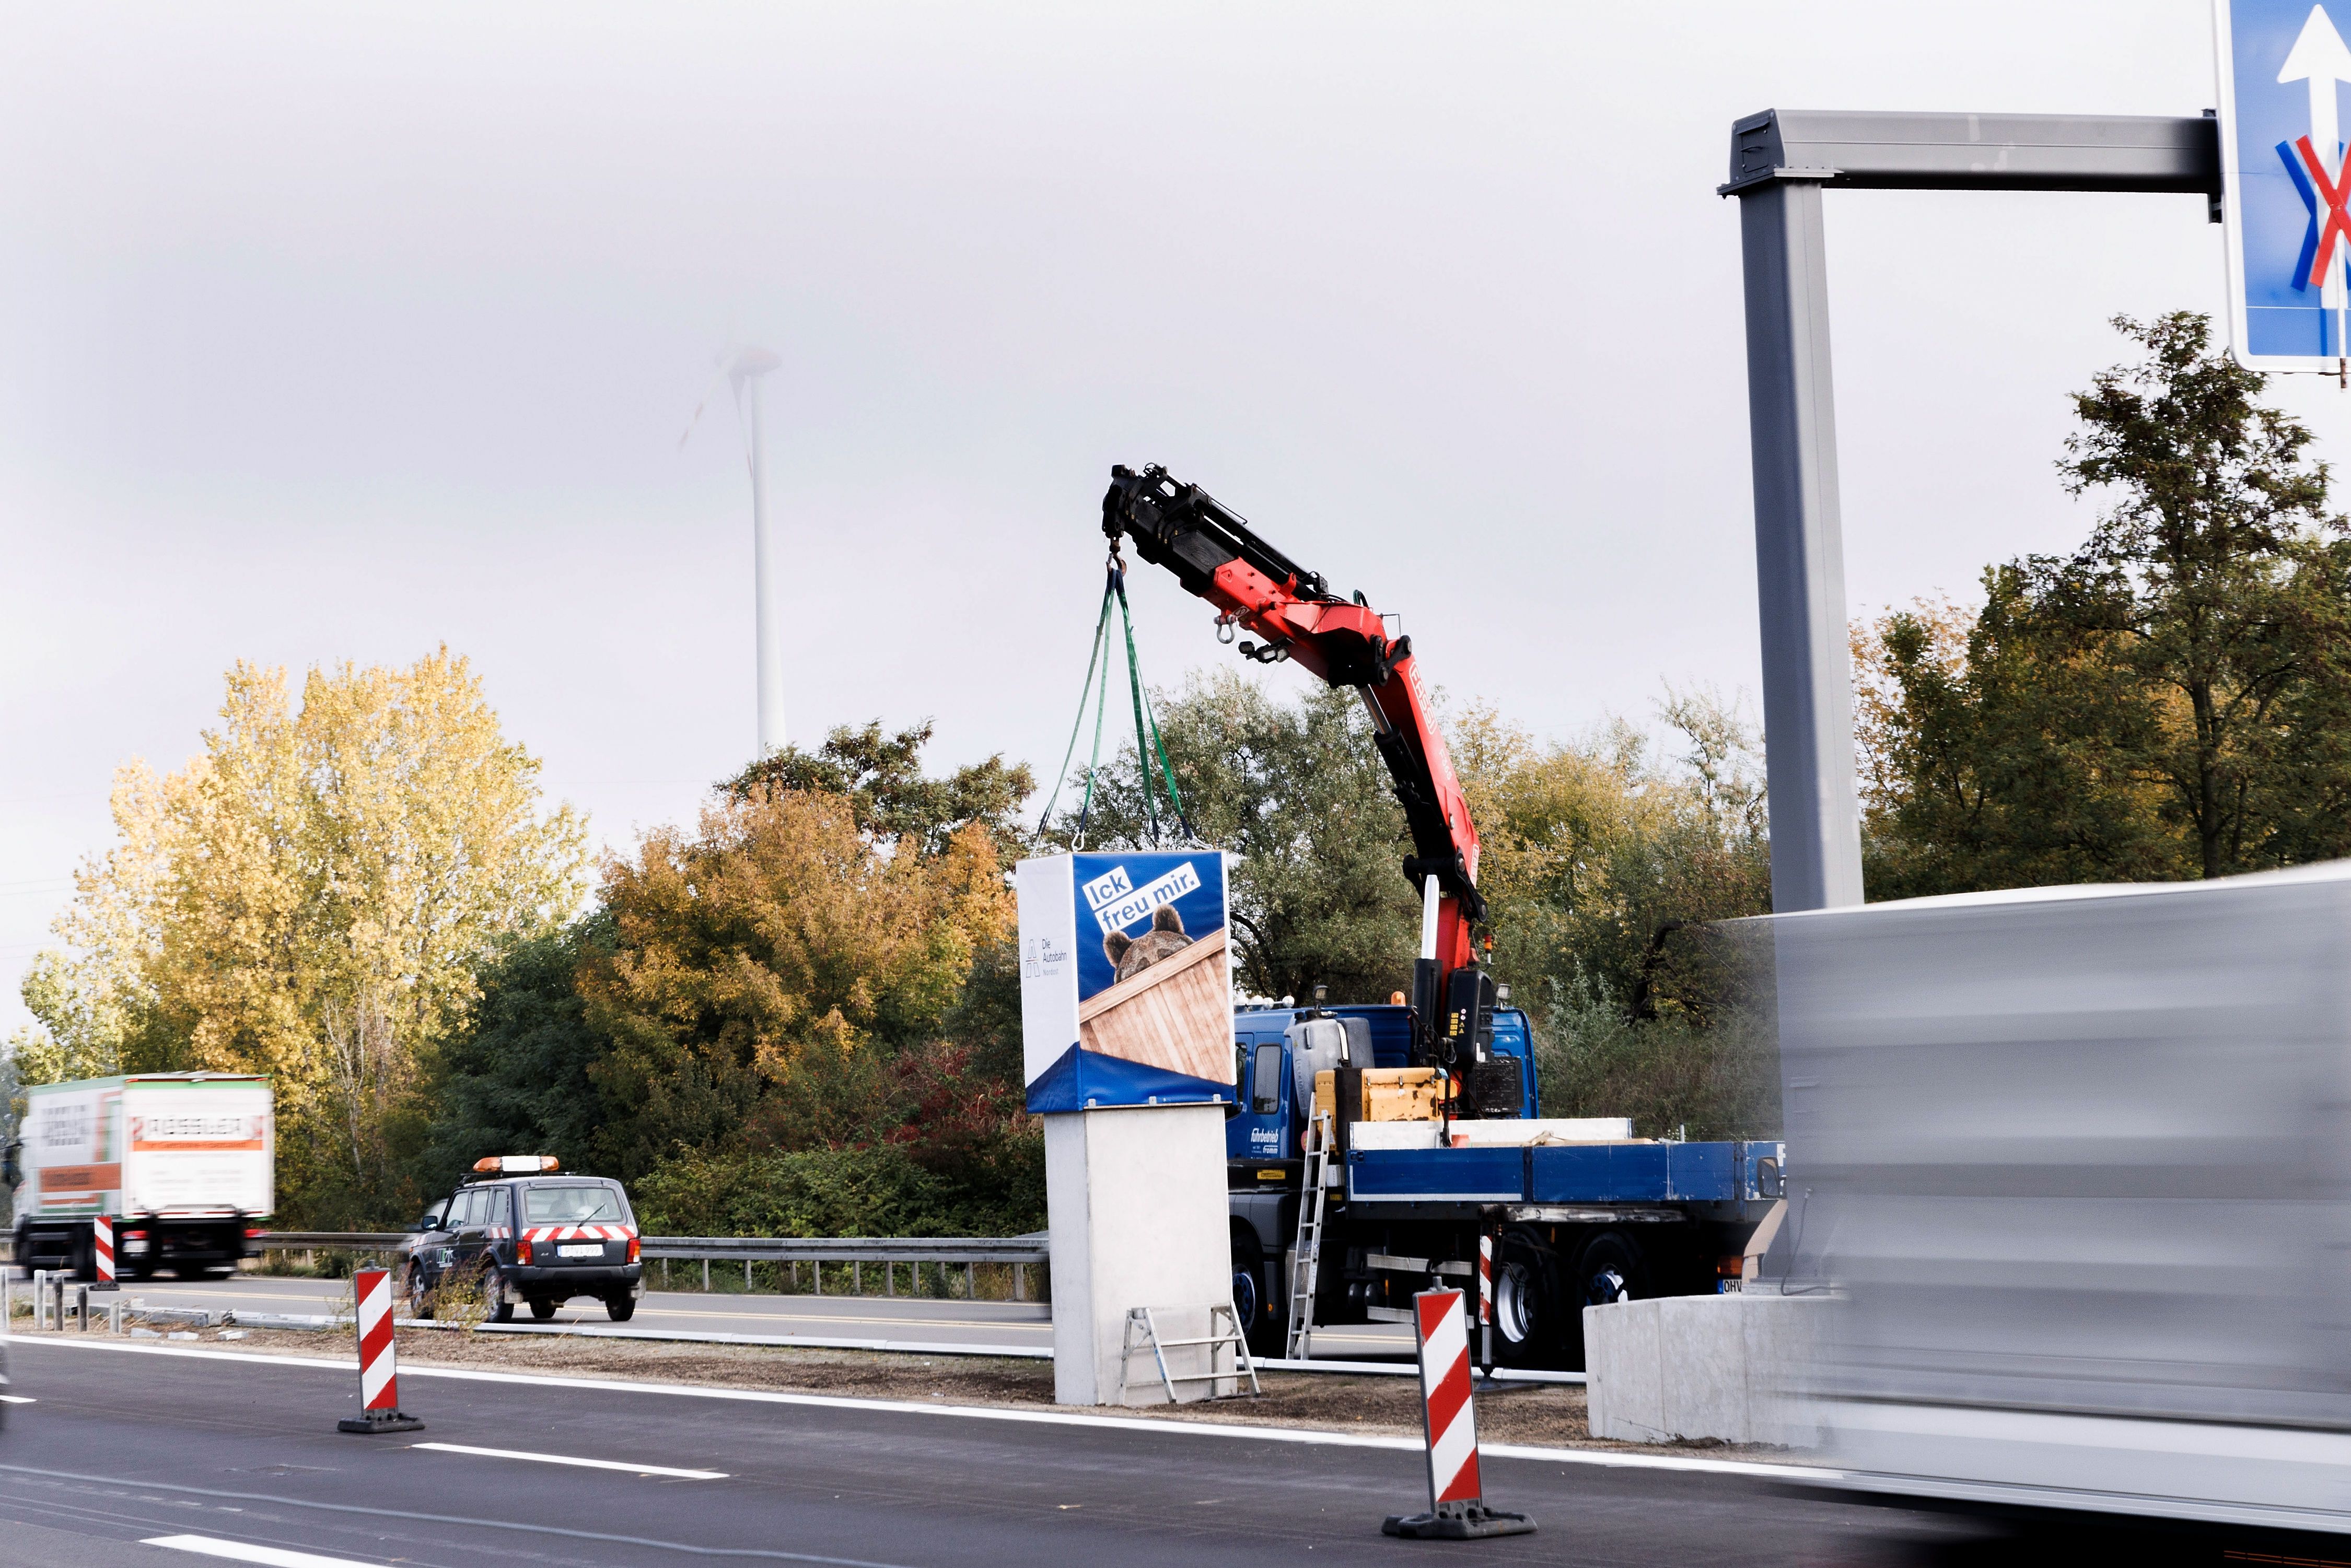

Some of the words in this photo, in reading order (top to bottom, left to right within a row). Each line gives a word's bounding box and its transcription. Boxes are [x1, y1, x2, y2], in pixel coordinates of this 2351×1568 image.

[1411, 666, 1436, 729] FASSI
[1089, 874, 1127, 904] Ick
[1102, 896, 1150, 931] freu
[1153, 873, 1195, 904] mir.
[1042, 938, 1051, 950] Die
[1043, 950, 1067, 963] Autobahn
[1263, 1145, 1278, 1154] fromm
[1724, 1280, 1742, 1292] OHV
